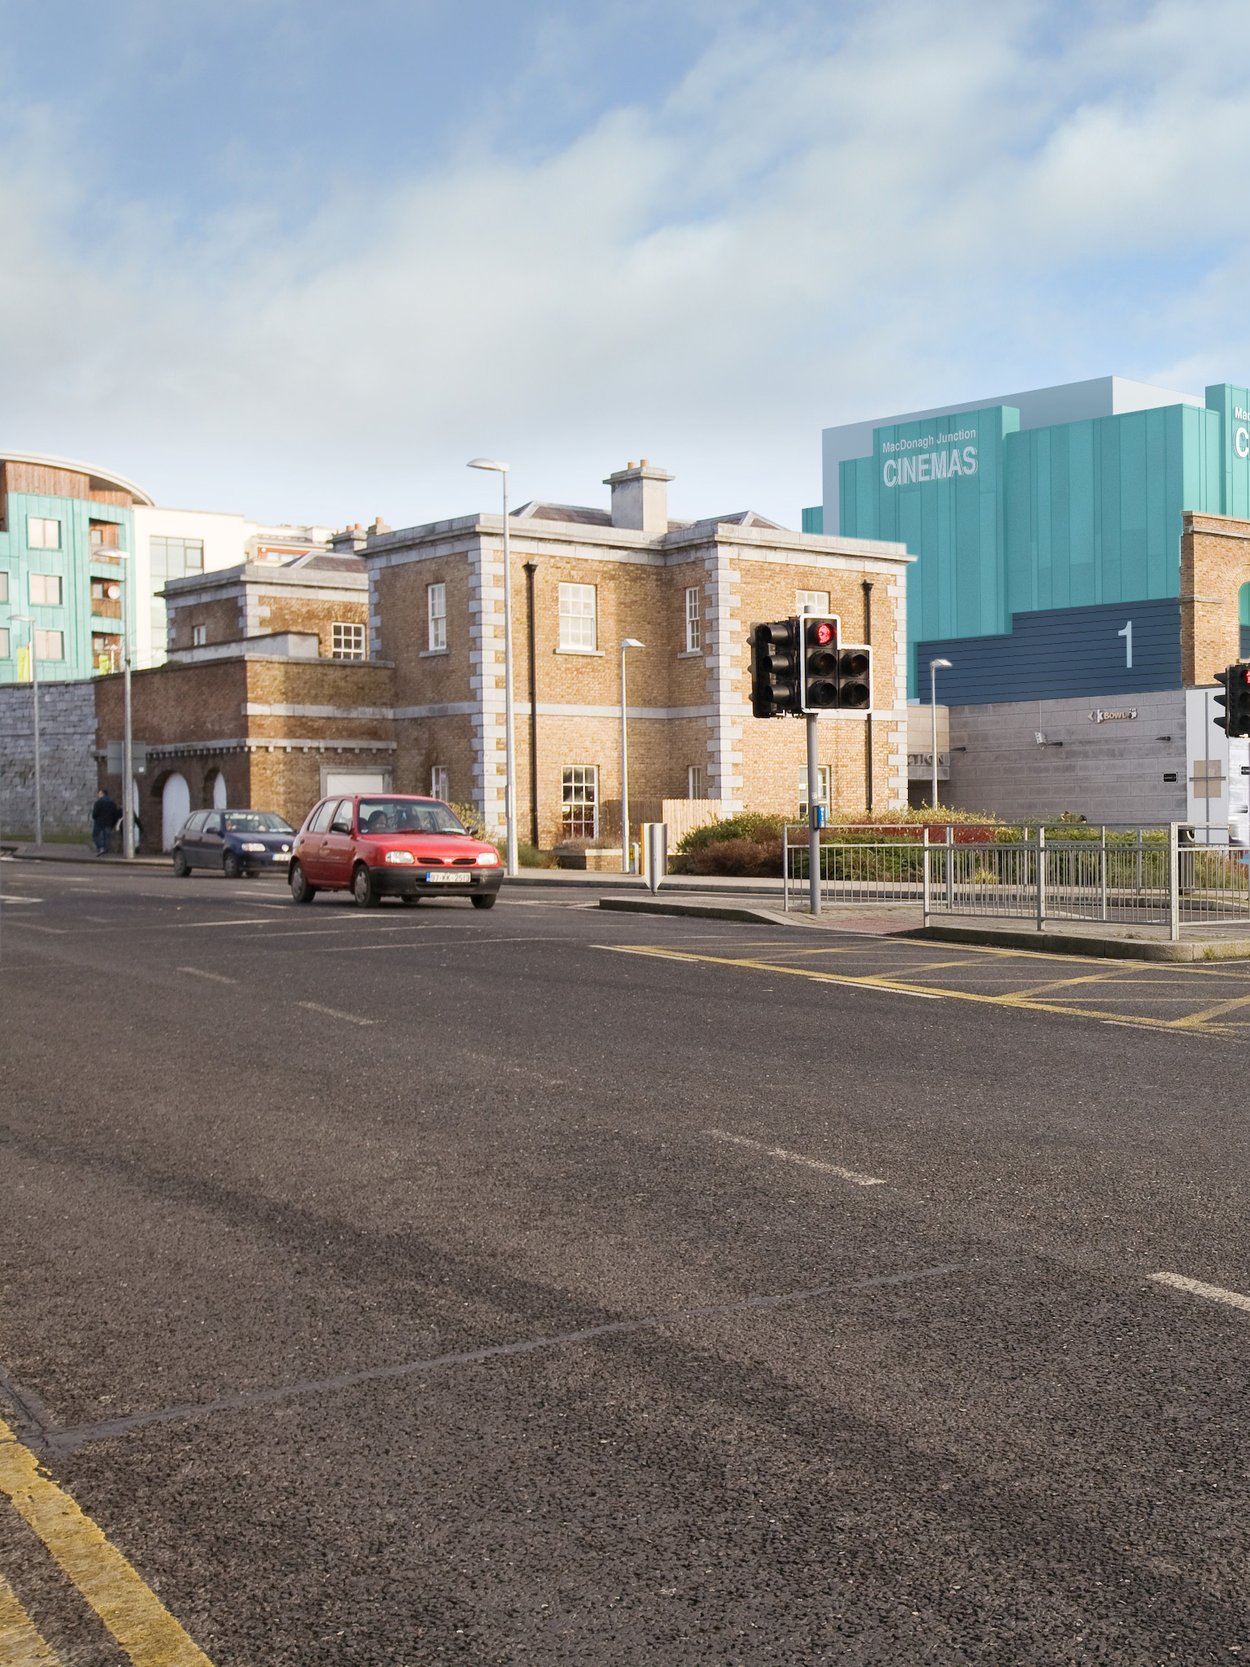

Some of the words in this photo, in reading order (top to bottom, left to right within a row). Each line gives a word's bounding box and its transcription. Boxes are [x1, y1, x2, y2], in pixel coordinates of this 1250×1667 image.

[882, 435, 934, 453] MacDonagh
[936, 429, 976, 444] Junction
[883, 446, 978, 487] CINEMAS
[1117, 620, 1133, 669] 1
